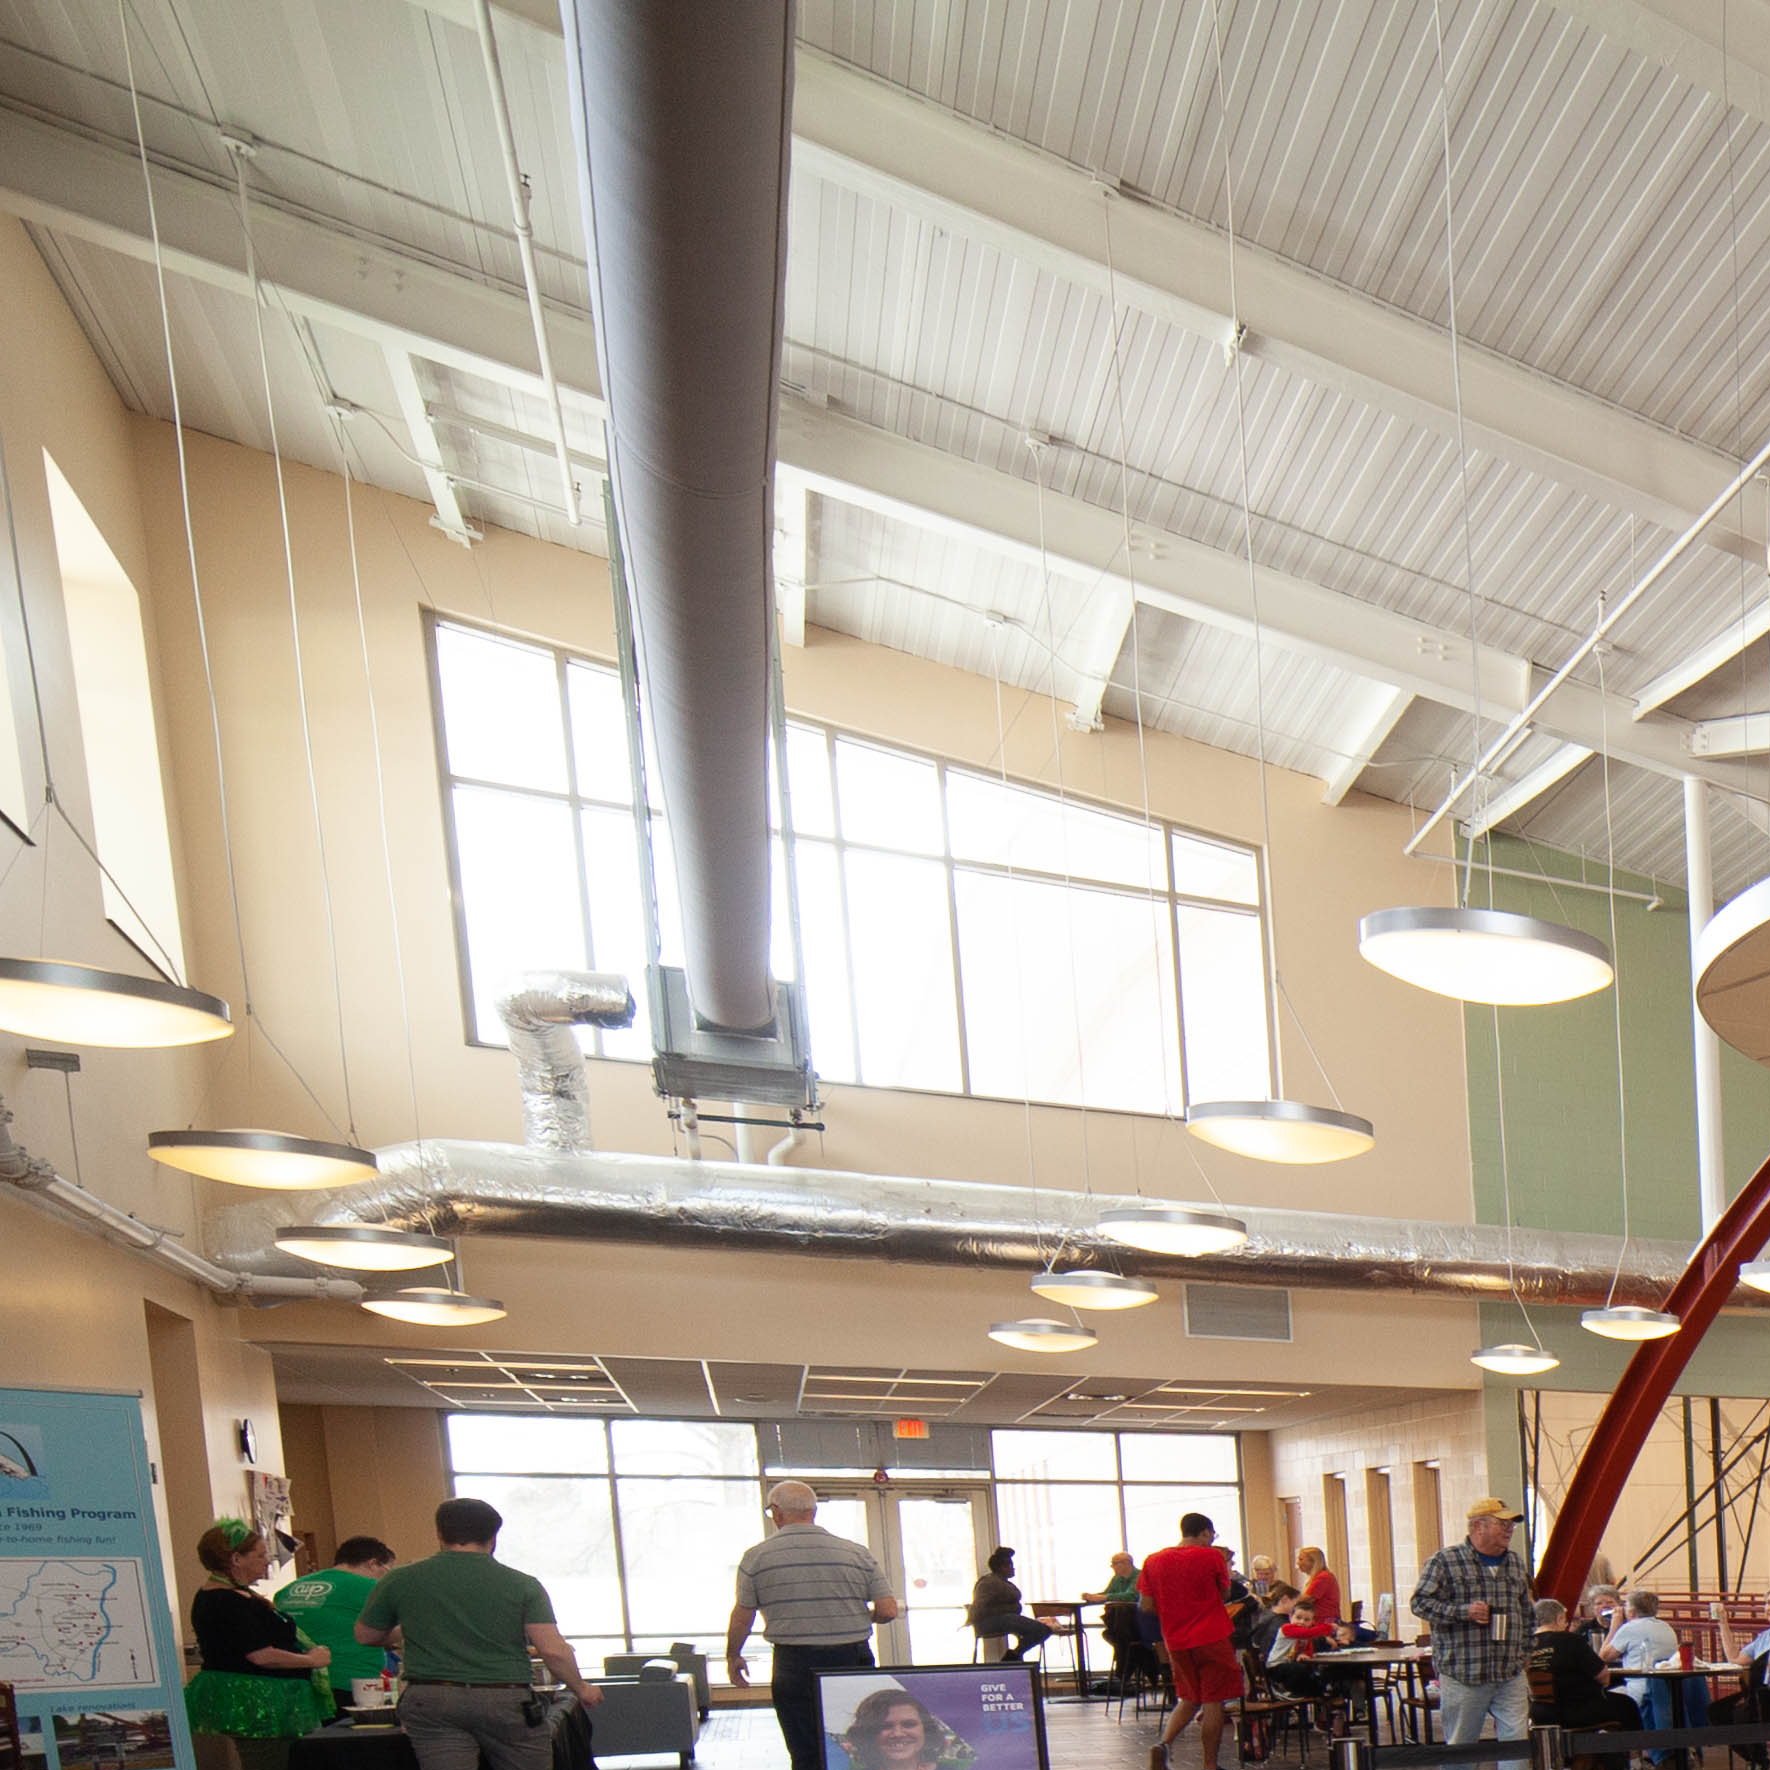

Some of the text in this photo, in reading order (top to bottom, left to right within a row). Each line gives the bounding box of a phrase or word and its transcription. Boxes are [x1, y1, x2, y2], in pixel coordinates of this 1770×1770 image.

[7, 1507, 136, 1521] Fishing Program
[57, 1536, 92, 1545] fishing
[95, 1536, 116, 1544] fun!
[981, 1683, 1006, 1692] GIVE
[50, 1701, 136, 1712] Lake renovations
[983, 1702, 1024, 1711] BETTER
